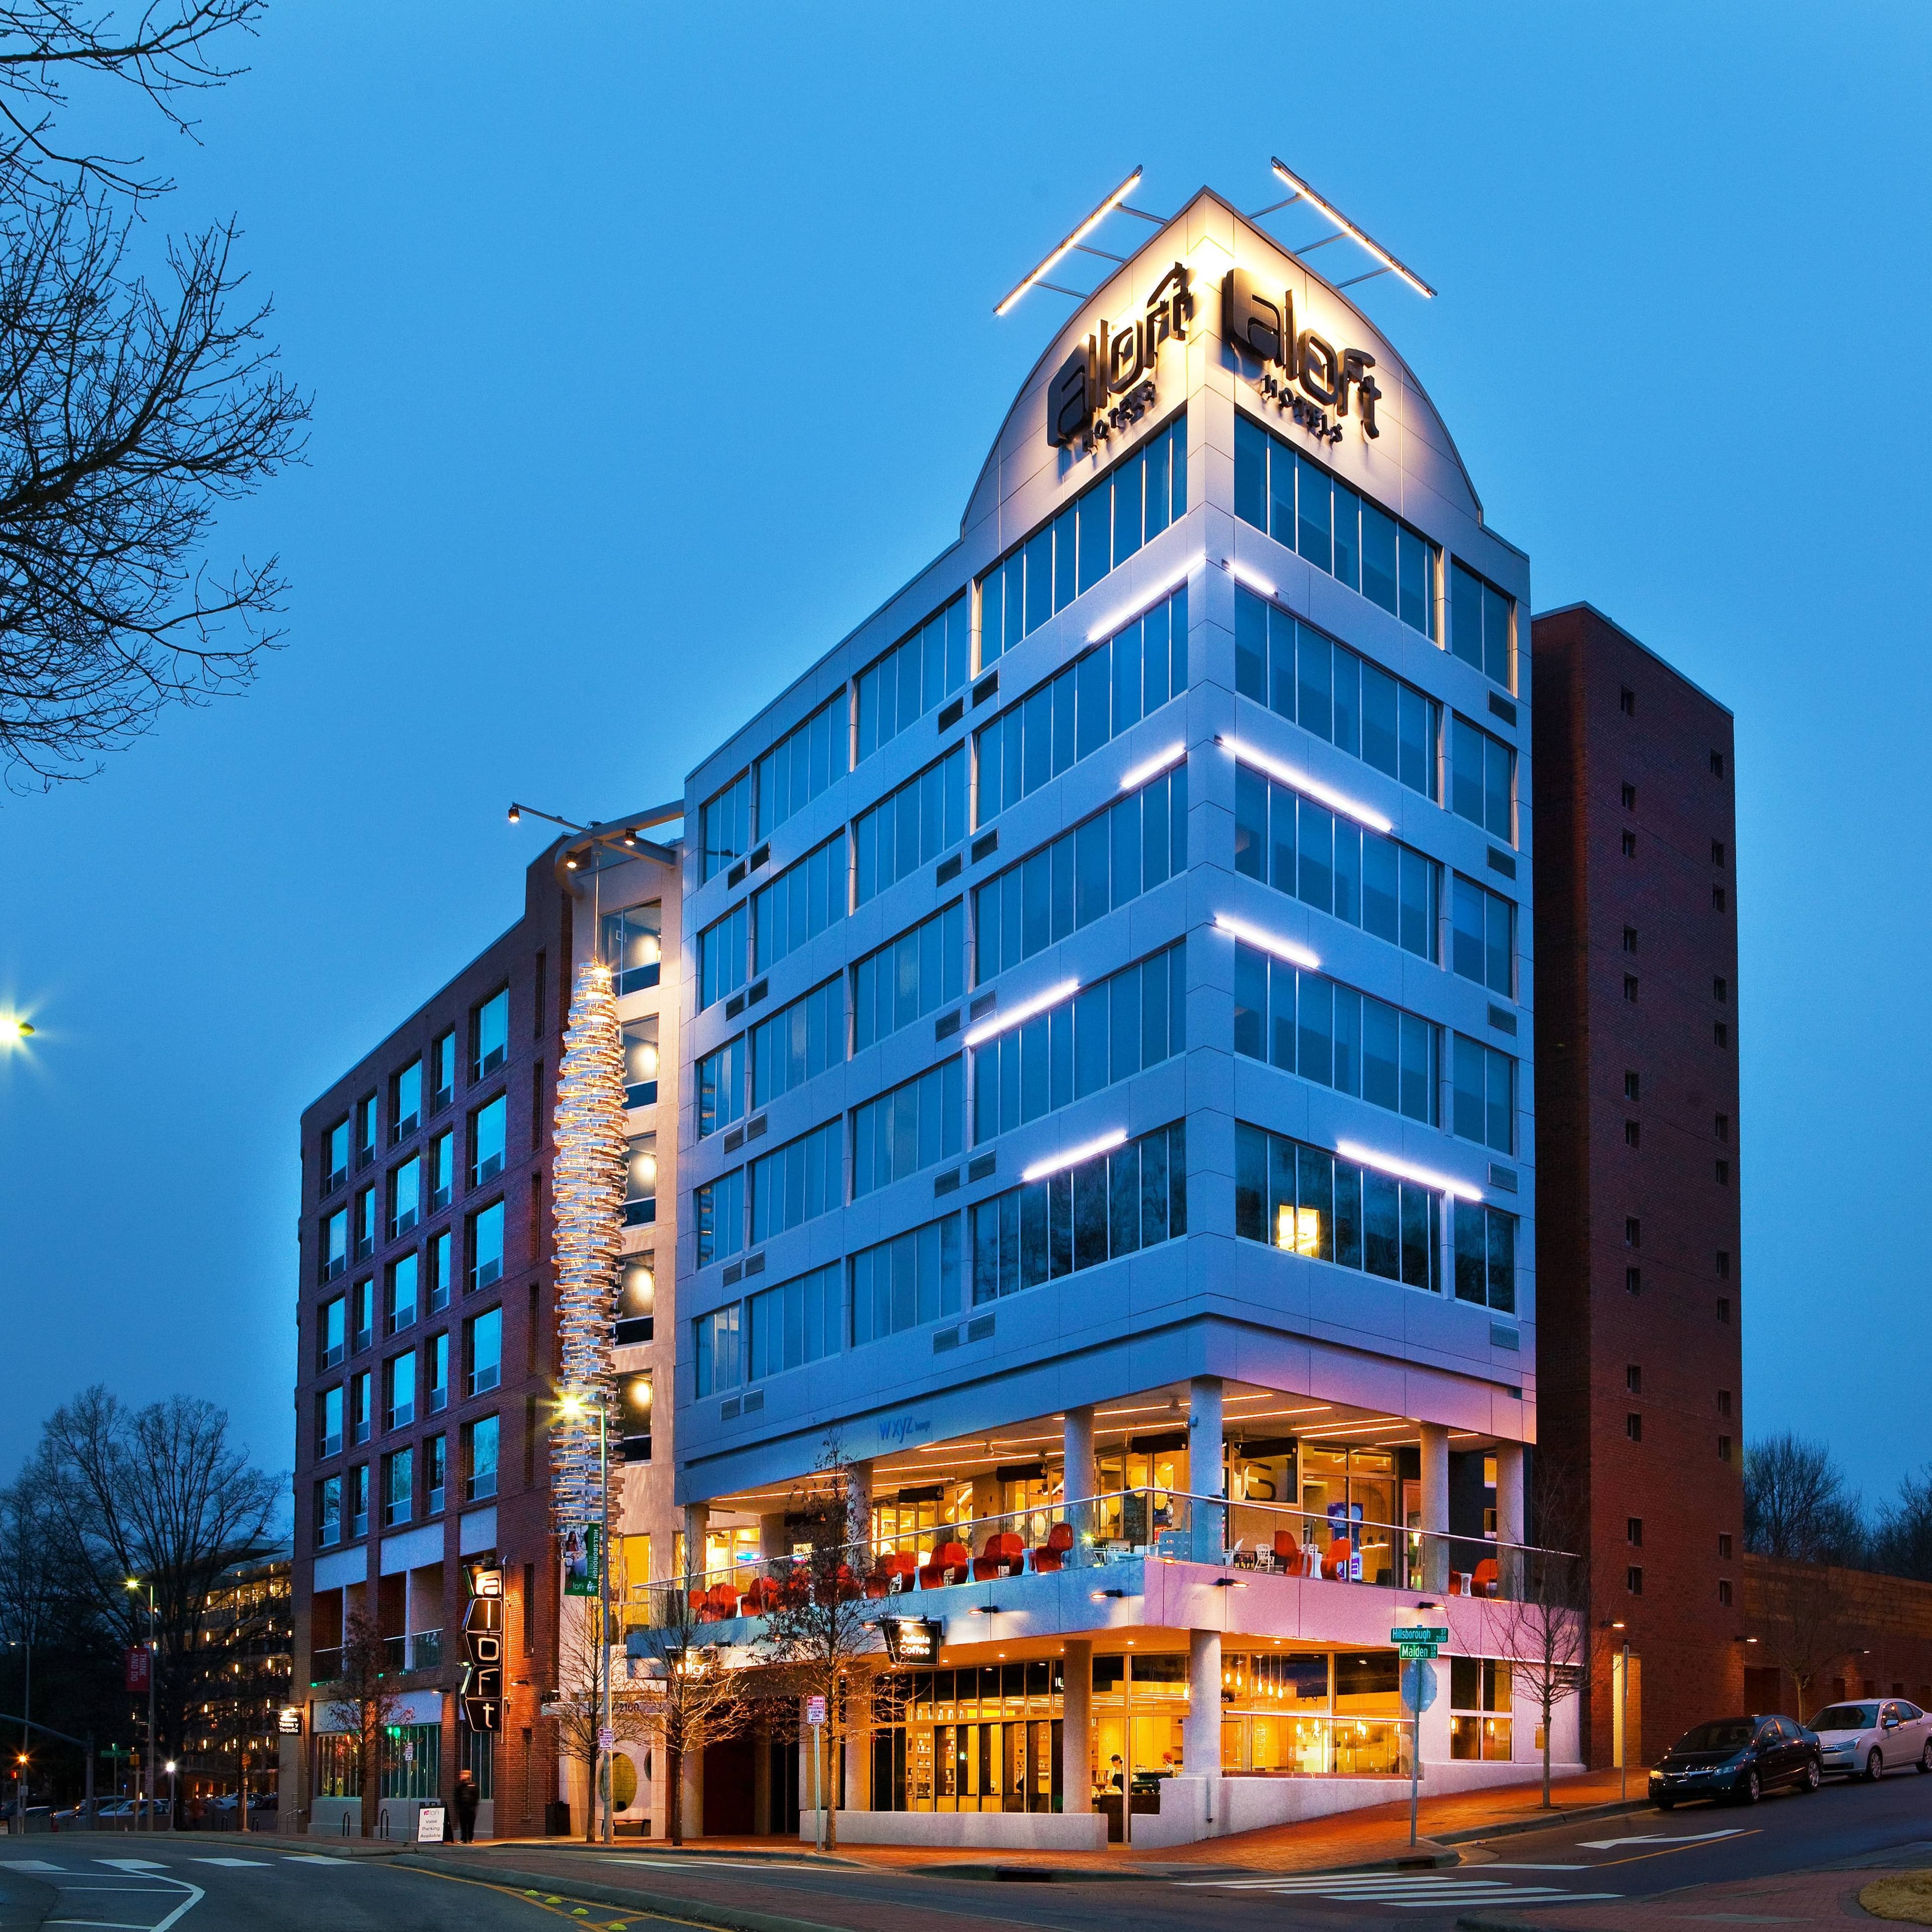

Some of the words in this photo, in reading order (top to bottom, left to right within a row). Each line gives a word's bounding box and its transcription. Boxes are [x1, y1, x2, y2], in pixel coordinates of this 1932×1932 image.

[1048, 262, 1188, 447] aloft
[1222, 268, 1382, 439] aloft
[1263, 374, 1342, 443] HOTELS
[1393, 1629, 1430, 1642] Hillsborough
[475, 1569, 502, 1728] aloft
[900, 1645, 930, 1655] Coffee
[1402, 1645, 1428, 1657] Maiden
[131, 1671, 138, 1681] DO
[620, 1703, 639, 1712] 2100
